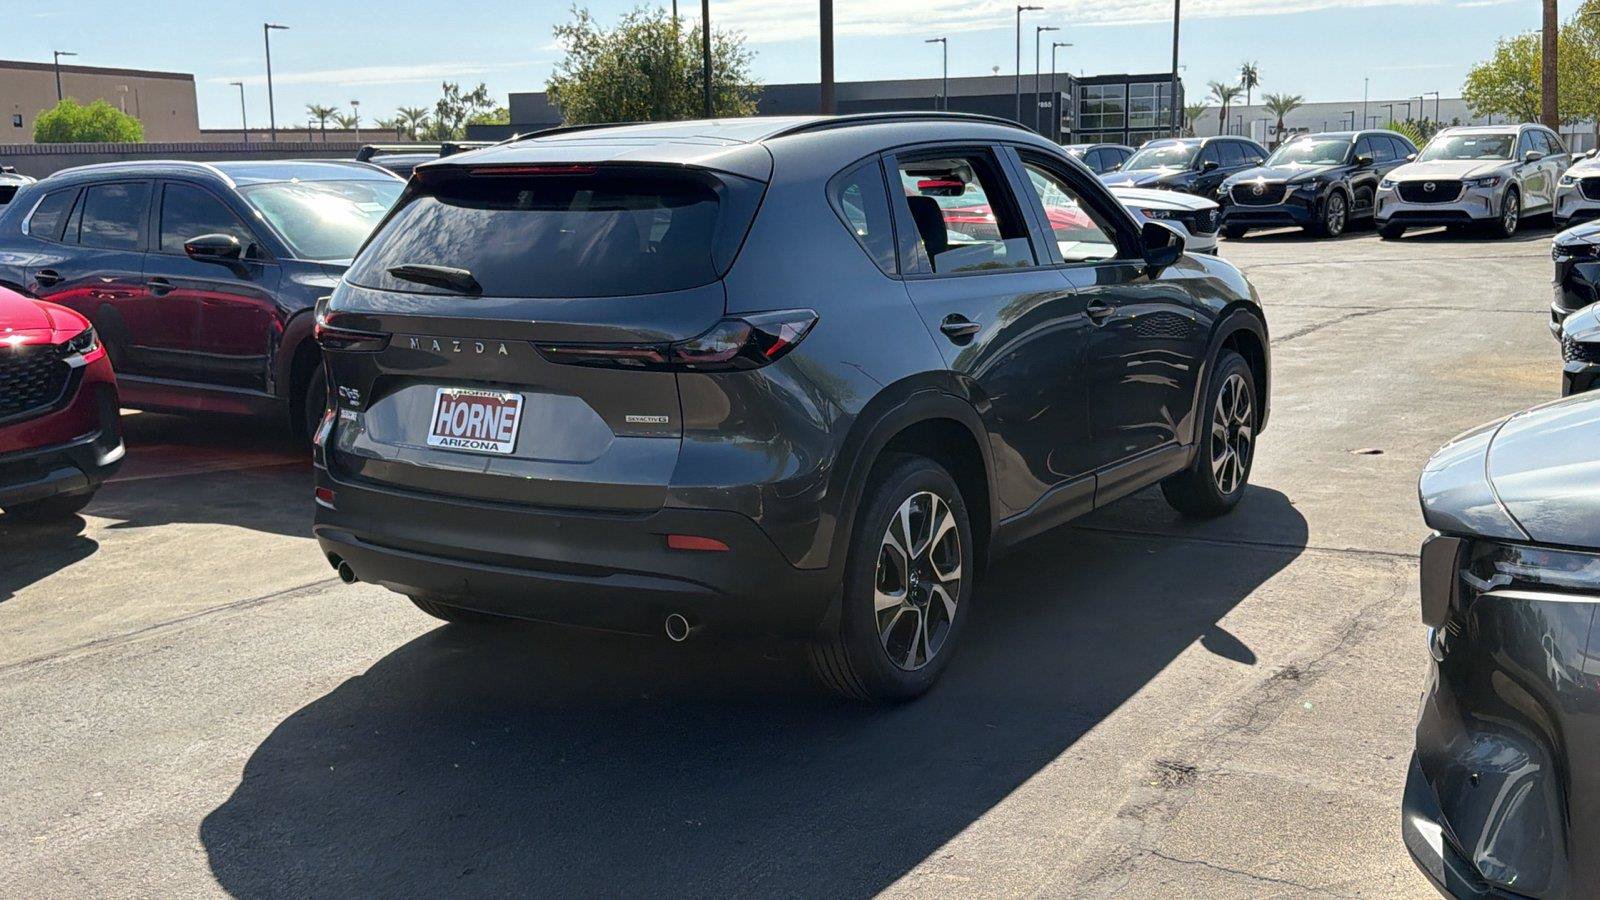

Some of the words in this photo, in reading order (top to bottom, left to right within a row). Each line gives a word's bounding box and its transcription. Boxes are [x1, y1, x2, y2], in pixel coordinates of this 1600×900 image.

[410, 337, 508, 355] MAZDA
[436, 400, 516, 440] HORNE
[439, 437, 499, 451] ARIZONA
